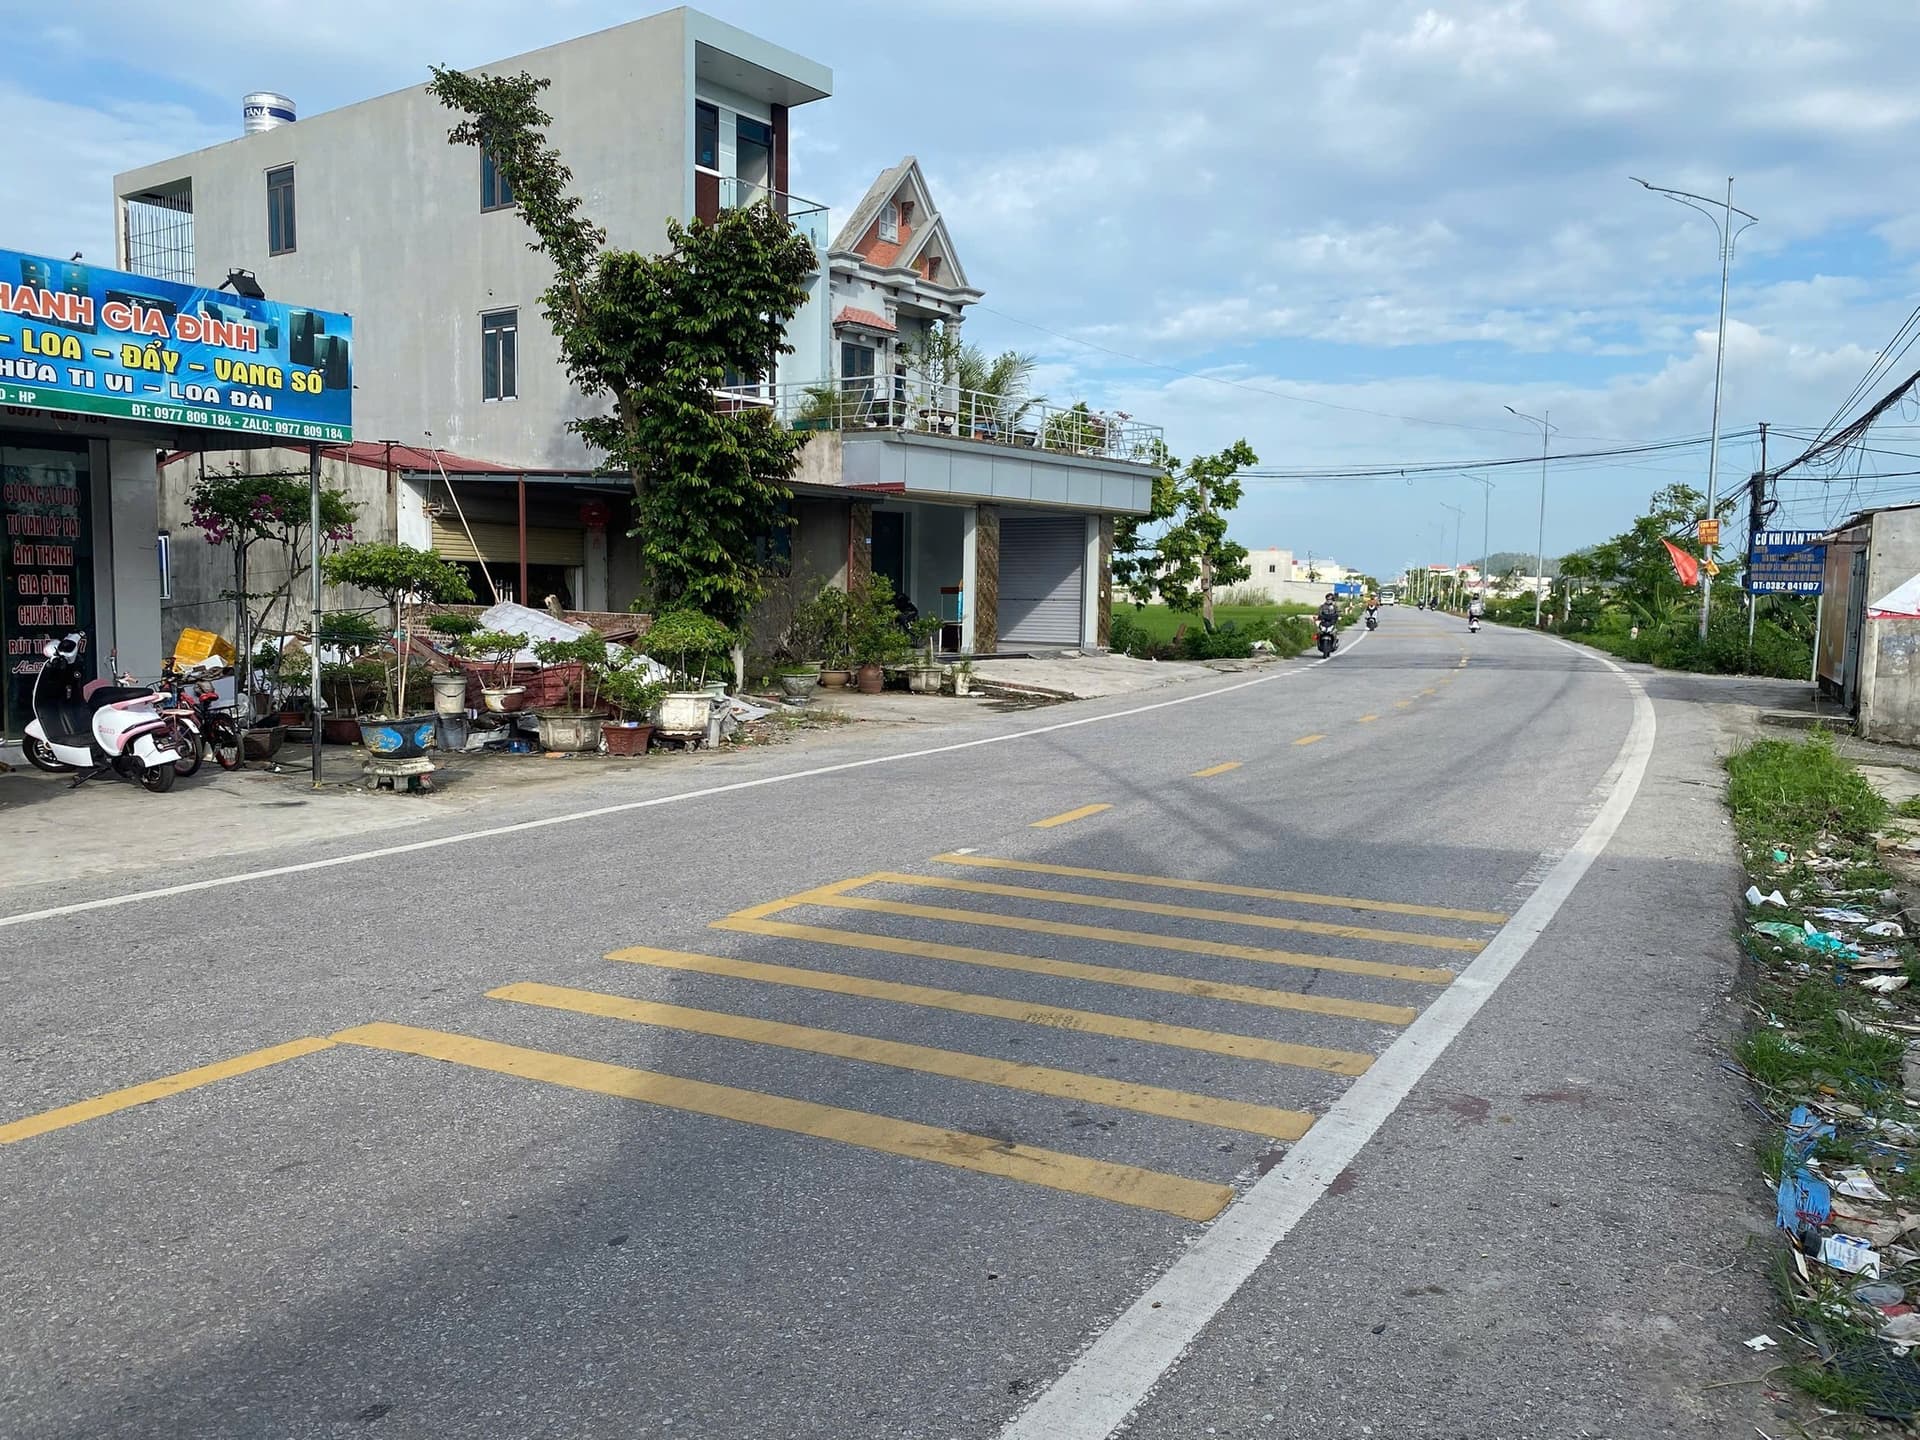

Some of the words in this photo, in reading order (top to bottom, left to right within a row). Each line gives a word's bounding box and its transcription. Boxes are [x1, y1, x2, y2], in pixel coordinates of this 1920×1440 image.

[101, 302, 170, 337] GIA
[176, 311, 257, 352] ĐÌNH
[22, 328, 82, 360] LOA
[121, 340, 179, 373] ĐẨY
[214, 358, 282, 389] VANG
[291, 368, 323, 394] SỐ
[19, 390, 36, 402] HP
[67, 368, 95, 388] TI
[104, 373, 133, 393] VI
[169, 382, 220, 404] LOA
[229, 391, 272, 411] ĐÀI
[132, 404, 151, 417] ĐT:
[154, 406, 182, 421] 0977
[187, 410, 208, 424] 809
[212, 413, 232, 427] 184
[242, 417, 272, 432] ZALO:
[275, 421, 300, 435] 0977
[303, 425, 322, 438] 809
[325, 428, 343, 440] 184
[14, 540, 34, 565] ÂM
[36, 545, 73, 567] THANH
[18, 575, 39, 595] GIA
[41, 570, 70, 595] ĐÌNH
[9, 636, 31, 655] RÚT
